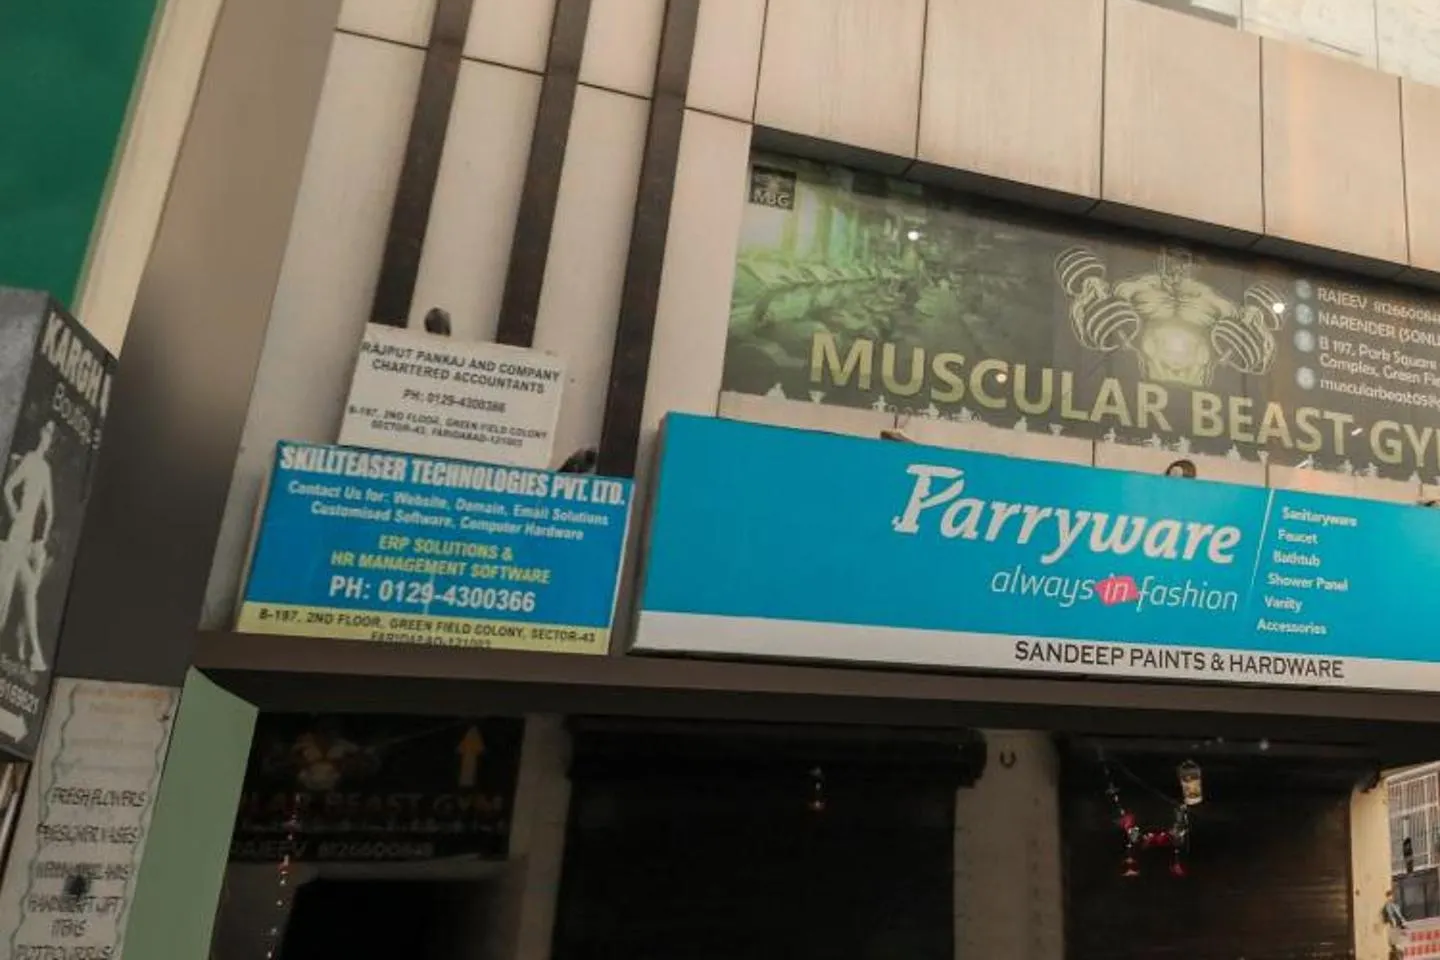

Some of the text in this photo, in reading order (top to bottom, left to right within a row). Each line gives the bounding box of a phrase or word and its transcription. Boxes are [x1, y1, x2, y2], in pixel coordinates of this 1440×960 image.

[1318, 310, 1397, 338] NARENDER
[361, 341, 561, 382] RAJPUT PANKAJ AND COMPANY
[1382, 364, 1420, 384] Green
[1393, 350, 1437, 370] Square
[372, 358, 545, 394] CHARTERED ACCOUNTANTS
[810, 331, 1173, 432] MUSCULAR
[1191, 390, 1355, 456] BEAST
[411, 458, 549, 498] TECHNOLOGIES
[551, 475, 588, 502] PVT.
[591, 480, 626, 506] LTD.
[288, 480, 342, 499] Contact
[344, 485, 363, 501] Us
[513, 504, 549, 520] Email
[552, 507, 610, 527] Solutions
[891, 463, 1242, 565] Parryware
[1282, 505, 1358, 528] Sanitaryware
[460, 515, 522, 536] Computer
[524, 523, 585, 541] Hardware
[1277, 528, 1319, 545] Faucet
[378, 534, 514, 562] ERP SOLUTIONS &
[1272, 549, 1321, 567] Bathtub
[330, 550, 552, 585] HR MANAGEMENT SOFTWARE
[1267, 571, 1349, 592] Shower Panel
[328, 575, 537, 613] PH: 0129-4300366
[991, 564, 1239, 613] always in fashion
[1264, 595, 1303, 614] Vanity
[306, 611, 334, 625] 2ND
[389, 616, 433, 632] GREEN
[435, 620, 471, 635] FIELD
[1256, 618, 1328, 635] Accessories
[1014, 639, 1345, 679] SANDEEP PAINTS & HARDWARE
